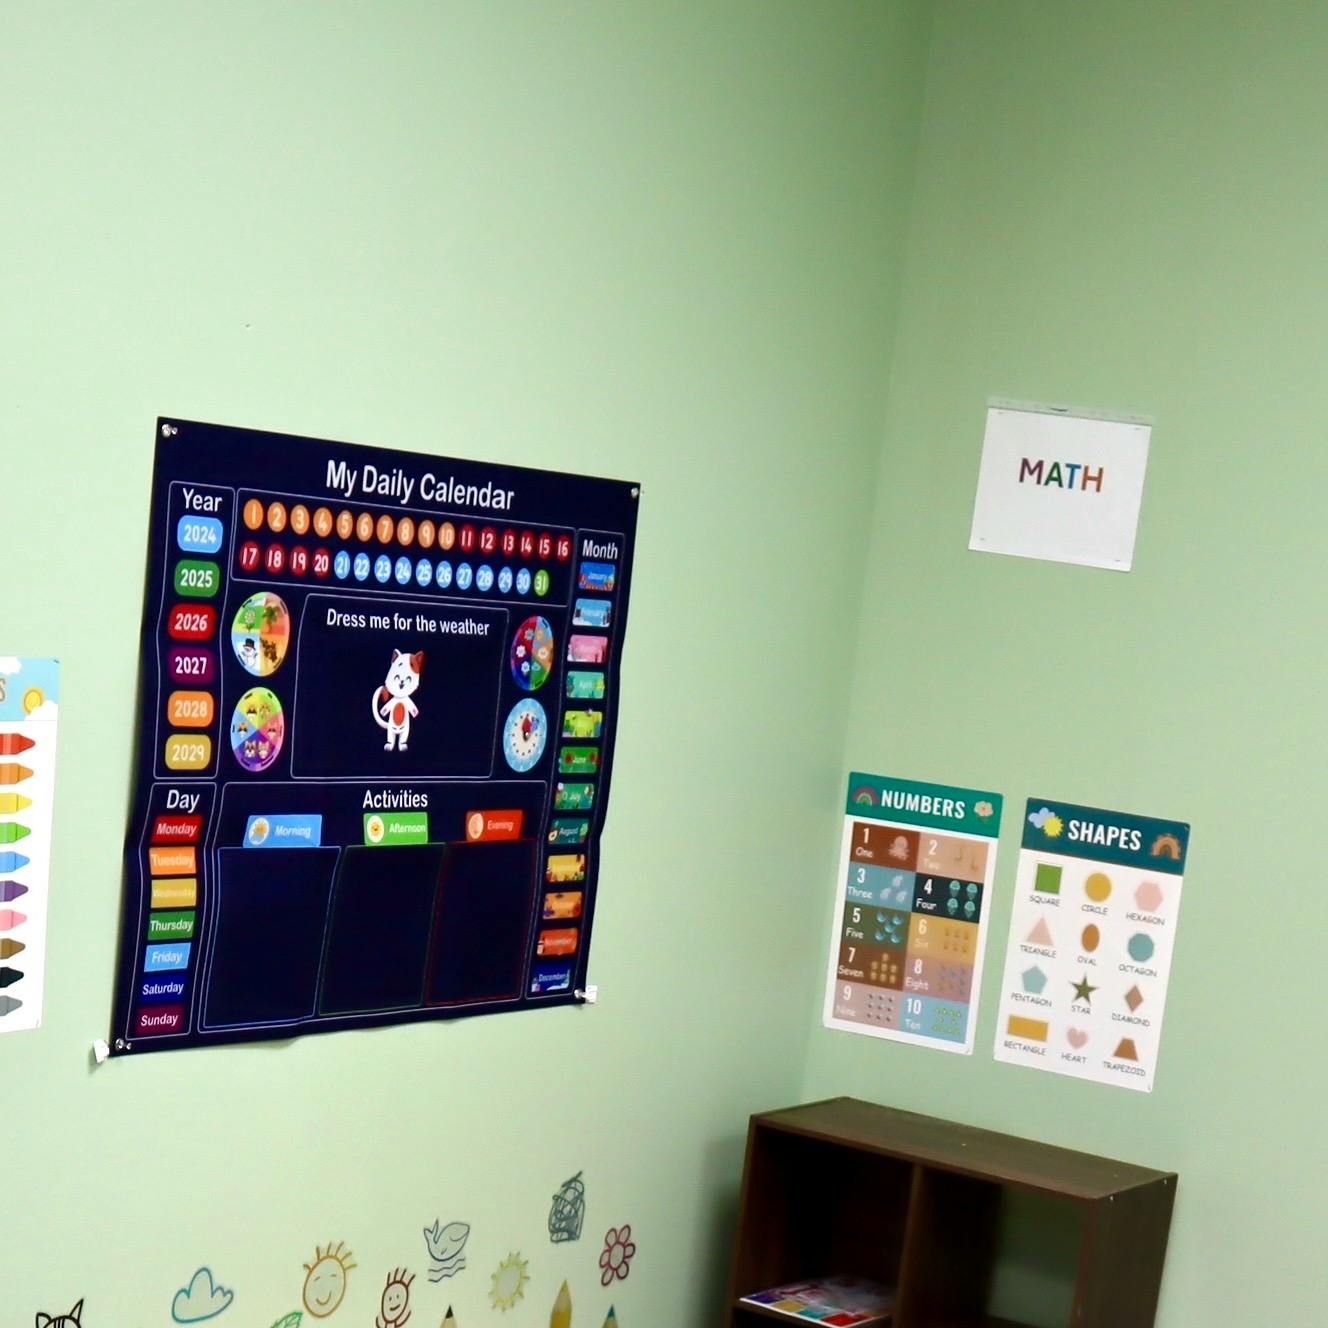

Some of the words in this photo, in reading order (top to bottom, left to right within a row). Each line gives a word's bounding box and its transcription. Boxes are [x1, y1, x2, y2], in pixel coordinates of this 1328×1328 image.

[1019, 457, 1104, 493] MATH
[326, 460, 357, 497] My
[362, 464, 414, 504] Daily
[420, 473, 514, 510] Calendar
[182, 487, 222, 512] Year
[184, 524, 217, 544] 2024
[252, 504, 257, 524] 1
[273, 508, 281, 527] 2
[296, 510, 304, 529] 3
[319, 513, 327, 531] 4
[341, 516, 349, 534] 5
[360, 518, 369, 536] 6
[382, 520, 389, 538] 7
[402, 522, 409, 540] 8
[423, 525, 431, 543] 9
[441, 528, 453, 545] 10
[462, 530, 472, 547] 11
[481, 532, 493, 549] 12
[504, 535, 514, 551] 13
[522, 537, 532, 553] 14
[539, 539, 550, 554] 15
[558, 541, 568, 556] 16
[583, 540, 618, 559] Month
[242, 547, 257, 566] 17
[268, 550, 282, 567] 18
[293, 552, 306, 569] 19
[315, 555, 329, 573] 20
[336, 556, 348, 574] 21
[355, 559, 369, 576] 22
[377, 561, 390, 578] 23
[396, 563, 411, 580] 24
[417, 563, 431, 581] 25
[438, 565, 451, 583] 26
[457, 568, 471, 584] 27
[477, 569, 492, 586] 28
[499, 572, 512, 588] 29
[517, 573, 530, 589] 30
[535, 574, 547, 591] 31
[180, 568, 213, 588] 2025
[175, 614, 208, 631] 2026
[326, 608, 366, 628] Dress
[370, 616, 391, 629] me
[394, 614, 412, 630] for
[416, 616, 436, 632] the
[440, 619, 490, 635] weather
[175, 656, 207, 674] 2027
[175, 700, 207, 717] 2028
[172, 744, 204, 761] 2029
[166, 789, 200, 813] Day
[363, 789, 428, 809] Activities
[881, 789, 965, 819] NUMBERS
[156, 823, 197, 837] Monday
[275, 826, 311, 838] Morning
[389, 823, 426, 833] Afternoon
[487, 820, 513, 831] Evening
[863, 828, 870, 843] 1
[1068, 820, 1142, 851] SHAPES
[929, 840, 937, 855] 2
[153, 854, 193, 868] Tuesday
[857, 868, 866, 884] 3
[924, 879, 932, 895] 4
[916, 898, 937, 911] Four
[1030, 894, 1060, 907] SQUARE
[852, 908, 861, 923] 5
[1081, 904, 1108, 915] CIRCLE
[151, 919, 193, 932] Thursday
[919, 919, 927, 935] 6
[152, 952, 182, 964] Friday
[848, 947, 856, 963] 7
[1077, 956, 1097, 966] OVAL
[838, 965, 864, 978] Seven
[914, 959, 922, 975] 8
[1119, 964, 1157, 977] OCTAGON
[143, 983, 184, 995] Saturday
[844, 985, 852, 1000] 9
[906, 999, 921, 1015] 10
[1011, 992, 1052, 1007] PENTAGON
[1072, 1005, 1091, 1015] STAR
[141, 1014, 178, 1027] Sunday
[1112, 1013, 1150, 1027] DIAMOND
[1061, 1053, 1086, 1064] HEART
[1102, 1061, 1146, 1077] TRAPEZOID
